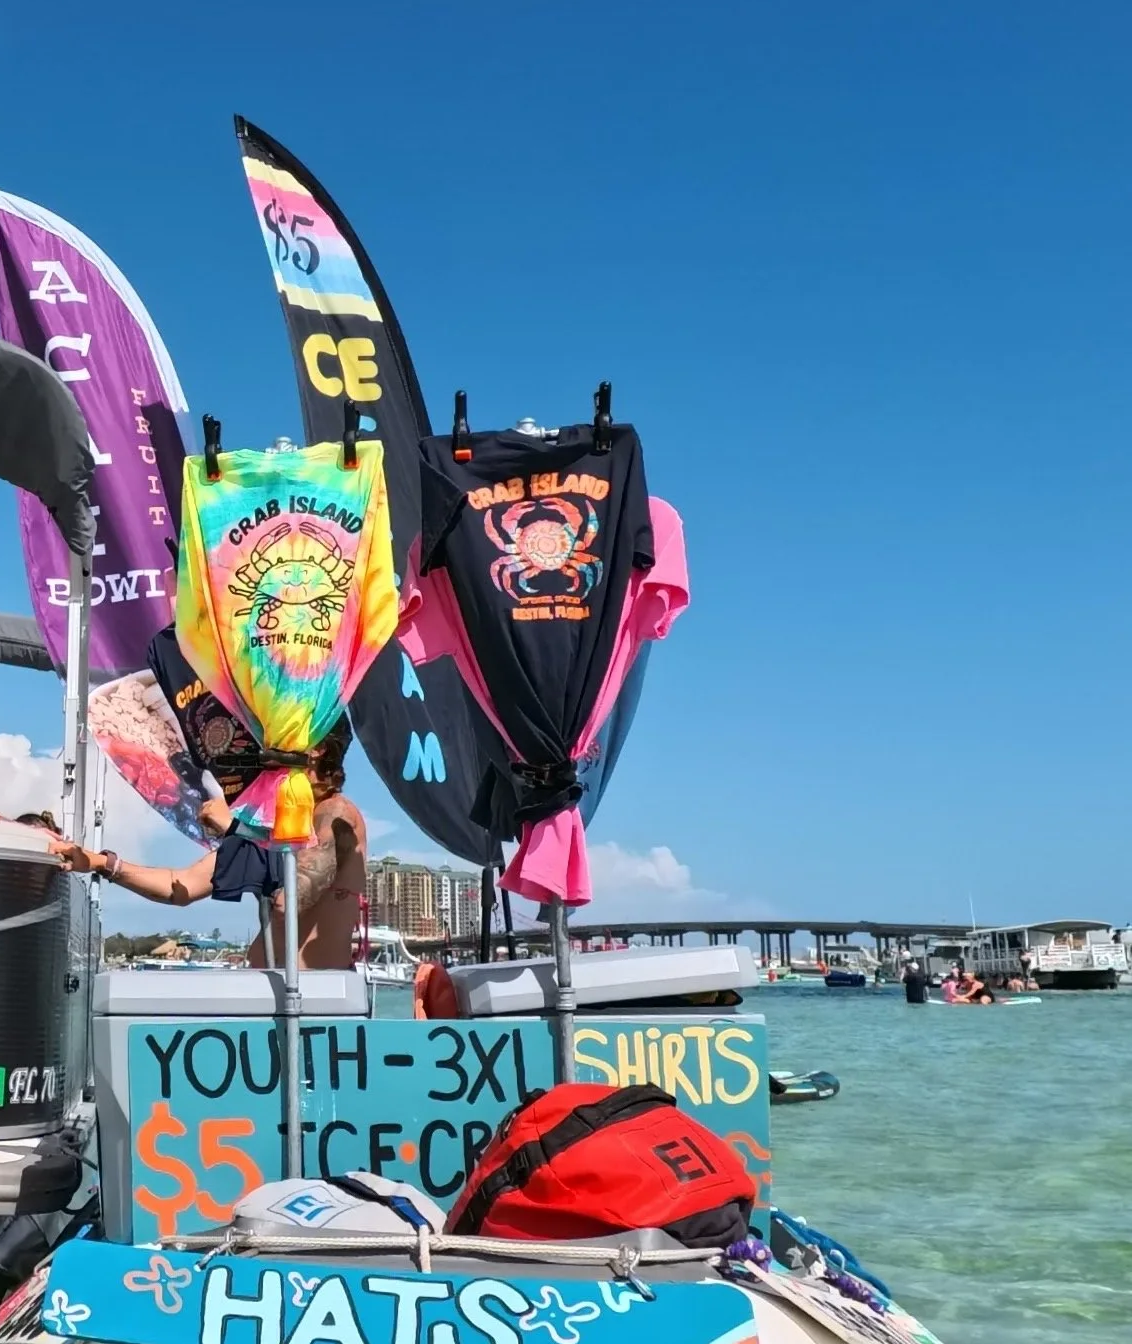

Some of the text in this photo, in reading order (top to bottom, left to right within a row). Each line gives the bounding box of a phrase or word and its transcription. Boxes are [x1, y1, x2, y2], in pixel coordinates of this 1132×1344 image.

[263, 199, 320, 276] $5
[130, 387, 168, 526] FRUIT
[467, 471, 610, 510] CRAB ISLAND
[229, 495, 364, 546] CRAB ISLAND
[9, 1066, 39, 1105] FL
[145, 1024, 367, 1099] YOUTH
[427, 1025, 545, 1105] 3XL
[134, 1101, 264, 1238] $5
